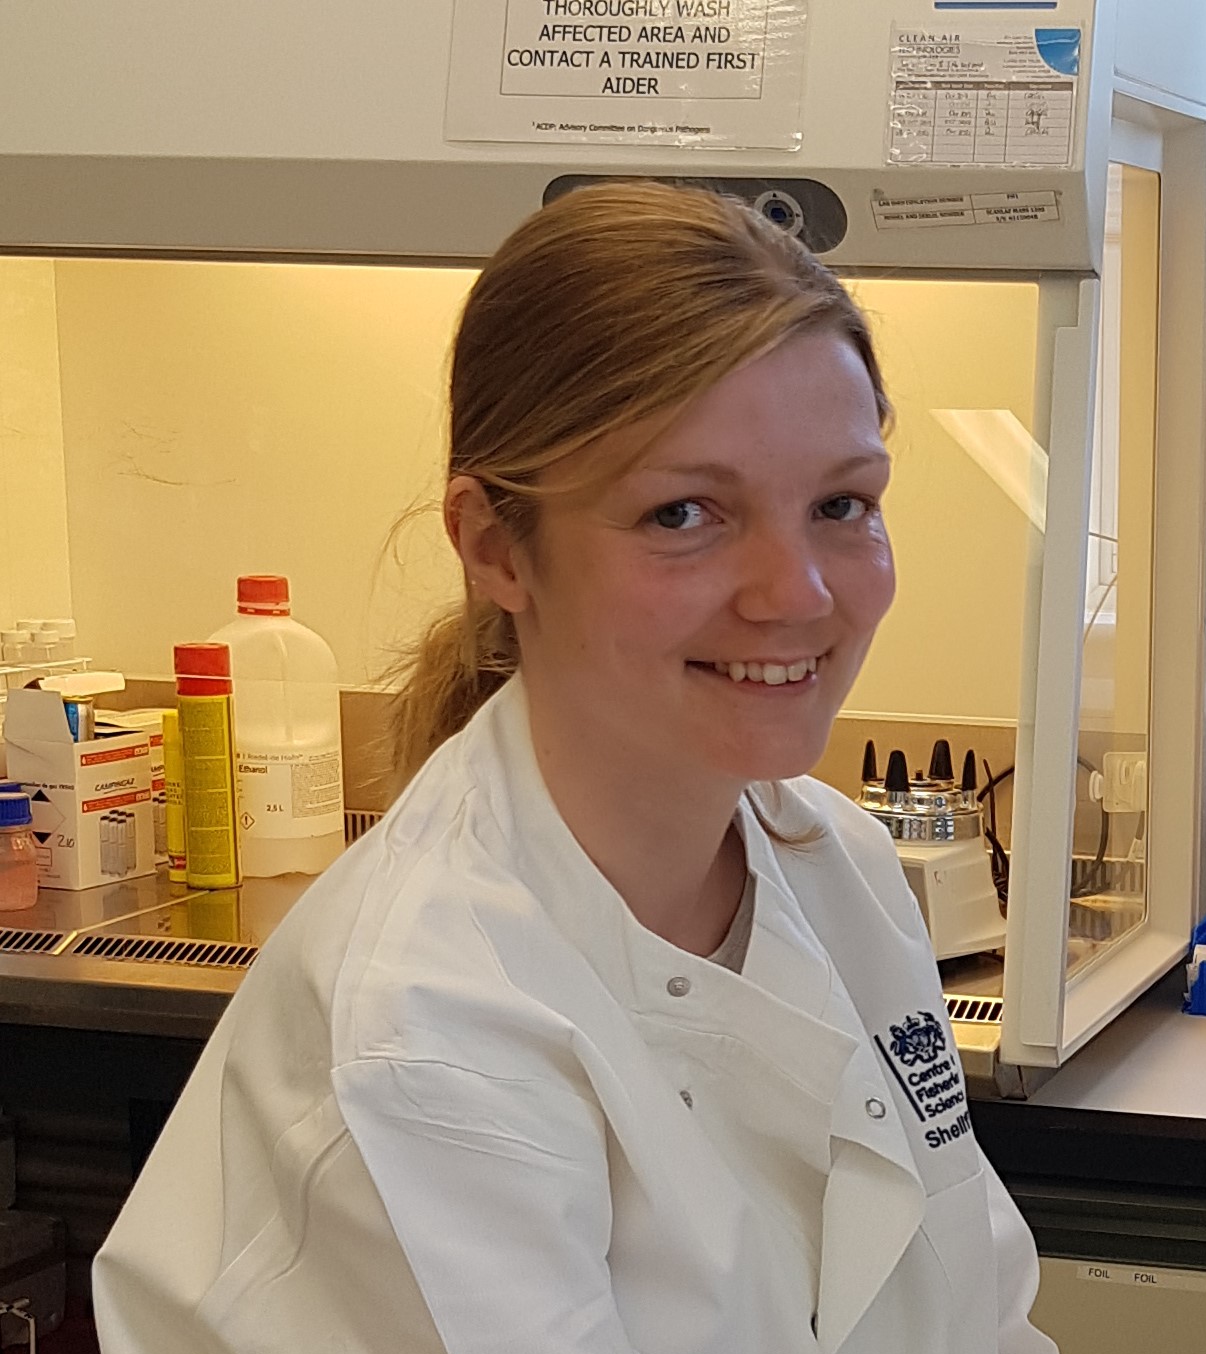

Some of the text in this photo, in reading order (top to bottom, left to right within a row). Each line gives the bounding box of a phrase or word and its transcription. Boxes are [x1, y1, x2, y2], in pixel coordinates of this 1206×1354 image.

[543, 0, 730, 18] THOROUGHLY WASH
[538, 24, 731, 43] AFFECTED AREA AND
[507, 50, 760, 70] CONTACT A TRAINED FIRST
[602, 77, 660, 95] AIDER
[239, 765, 267, 773] Ethanol
[908, 1060, 951, 1086] Centre
[1088, 1268, 1157, 1284] FOIL FOIL
